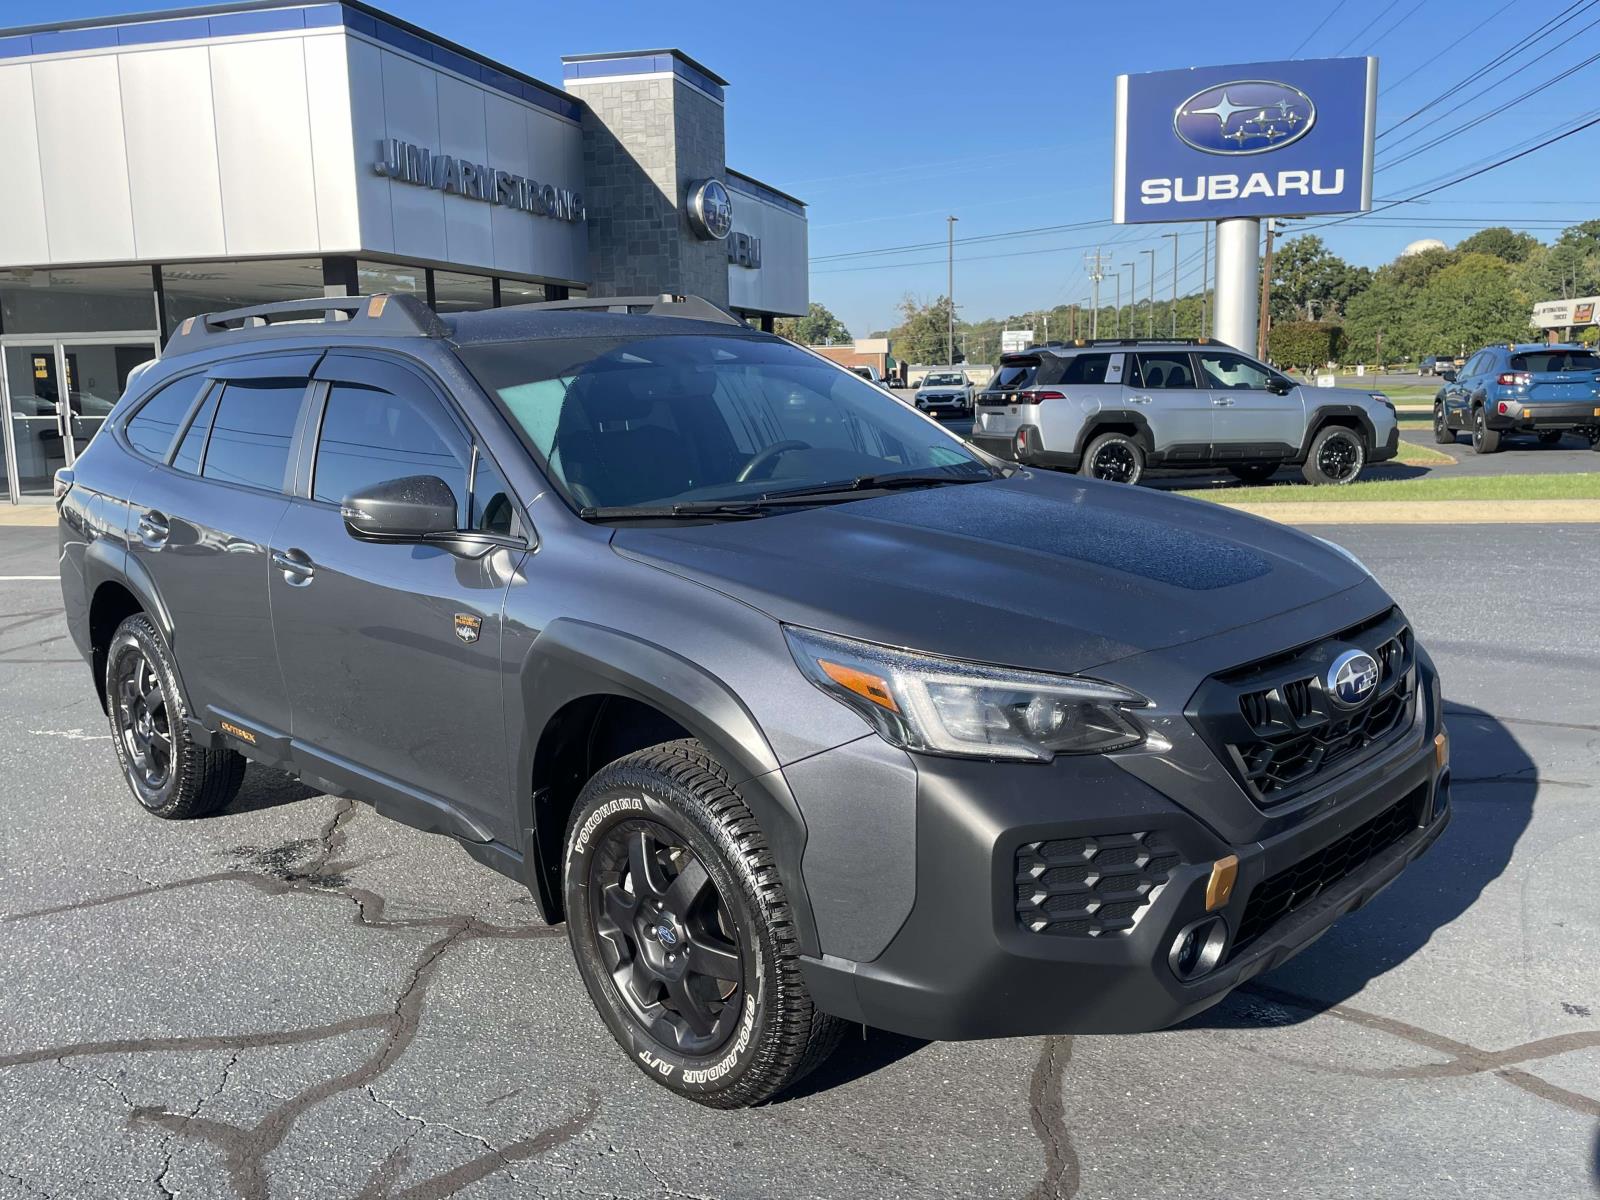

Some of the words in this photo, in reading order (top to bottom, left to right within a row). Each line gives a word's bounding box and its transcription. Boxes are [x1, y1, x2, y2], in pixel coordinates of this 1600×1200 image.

[1140, 168, 1345, 205] SUBARU
[574, 798, 643, 854] YOKOHAMA
[682, 993, 756, 1083] GEOLANDAR
[638, 1050, 674, 1076] A/T
